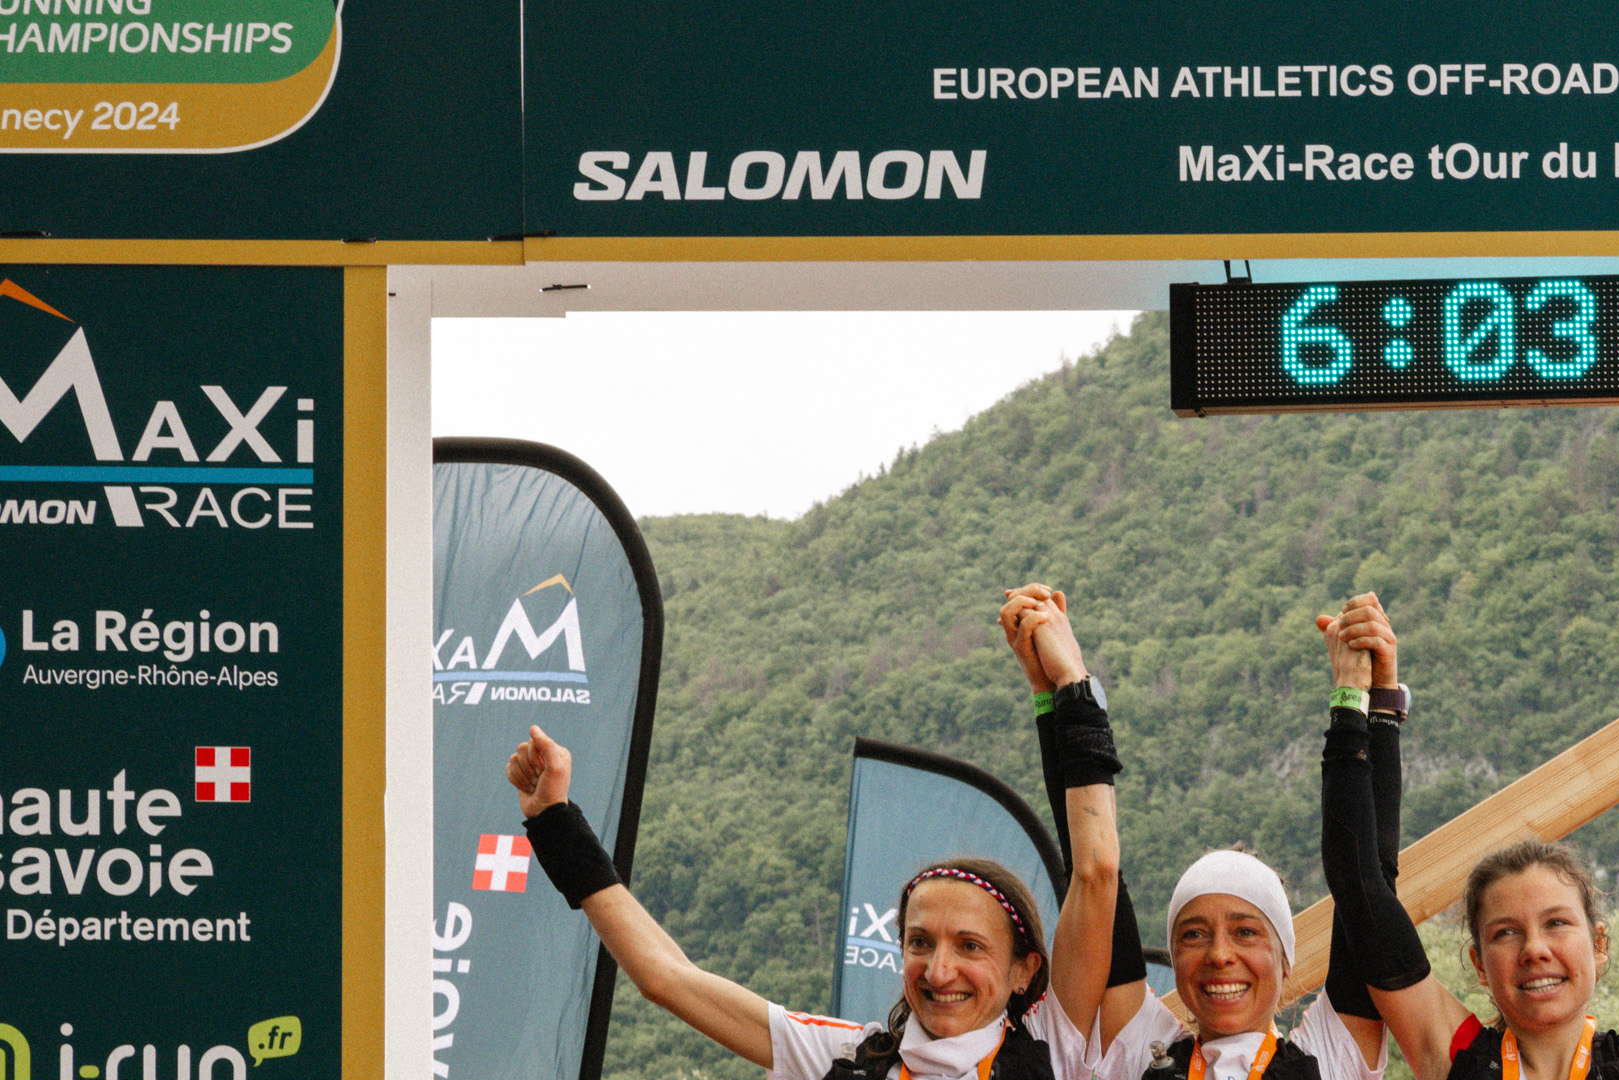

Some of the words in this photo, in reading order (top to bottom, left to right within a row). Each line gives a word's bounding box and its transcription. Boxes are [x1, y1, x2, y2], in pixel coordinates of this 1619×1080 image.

[0, 22, 294, 53] HAMPIONSHIPS
[933, 67, 1160, 99] EUROPEAN
[1170, 65, 1395, 97] ATHLETICS
[1406, 63, 1619, 96] OFF-ROAD
[1, 108, 84, 140] necy
[91, 101, 181, 130] 2024
[573, 150, 988, 201] SALOMON
[1178, 143, 1415, 182] MaXi-Race
[1428, 143, 1524, 180] tOur
[1541, 143, 1598, 179] du
[104, 486, 315, 530] RACE
[22, 609, 79, 651] La
[95, 608, 280, 662] Région
[22, 664, 279, 691] Auvergne-Rhône-Alpes
[0, 768, 183, 837] aute
[0, 844, 214, 898] avoie
[5, 908, 252, 947] Département
